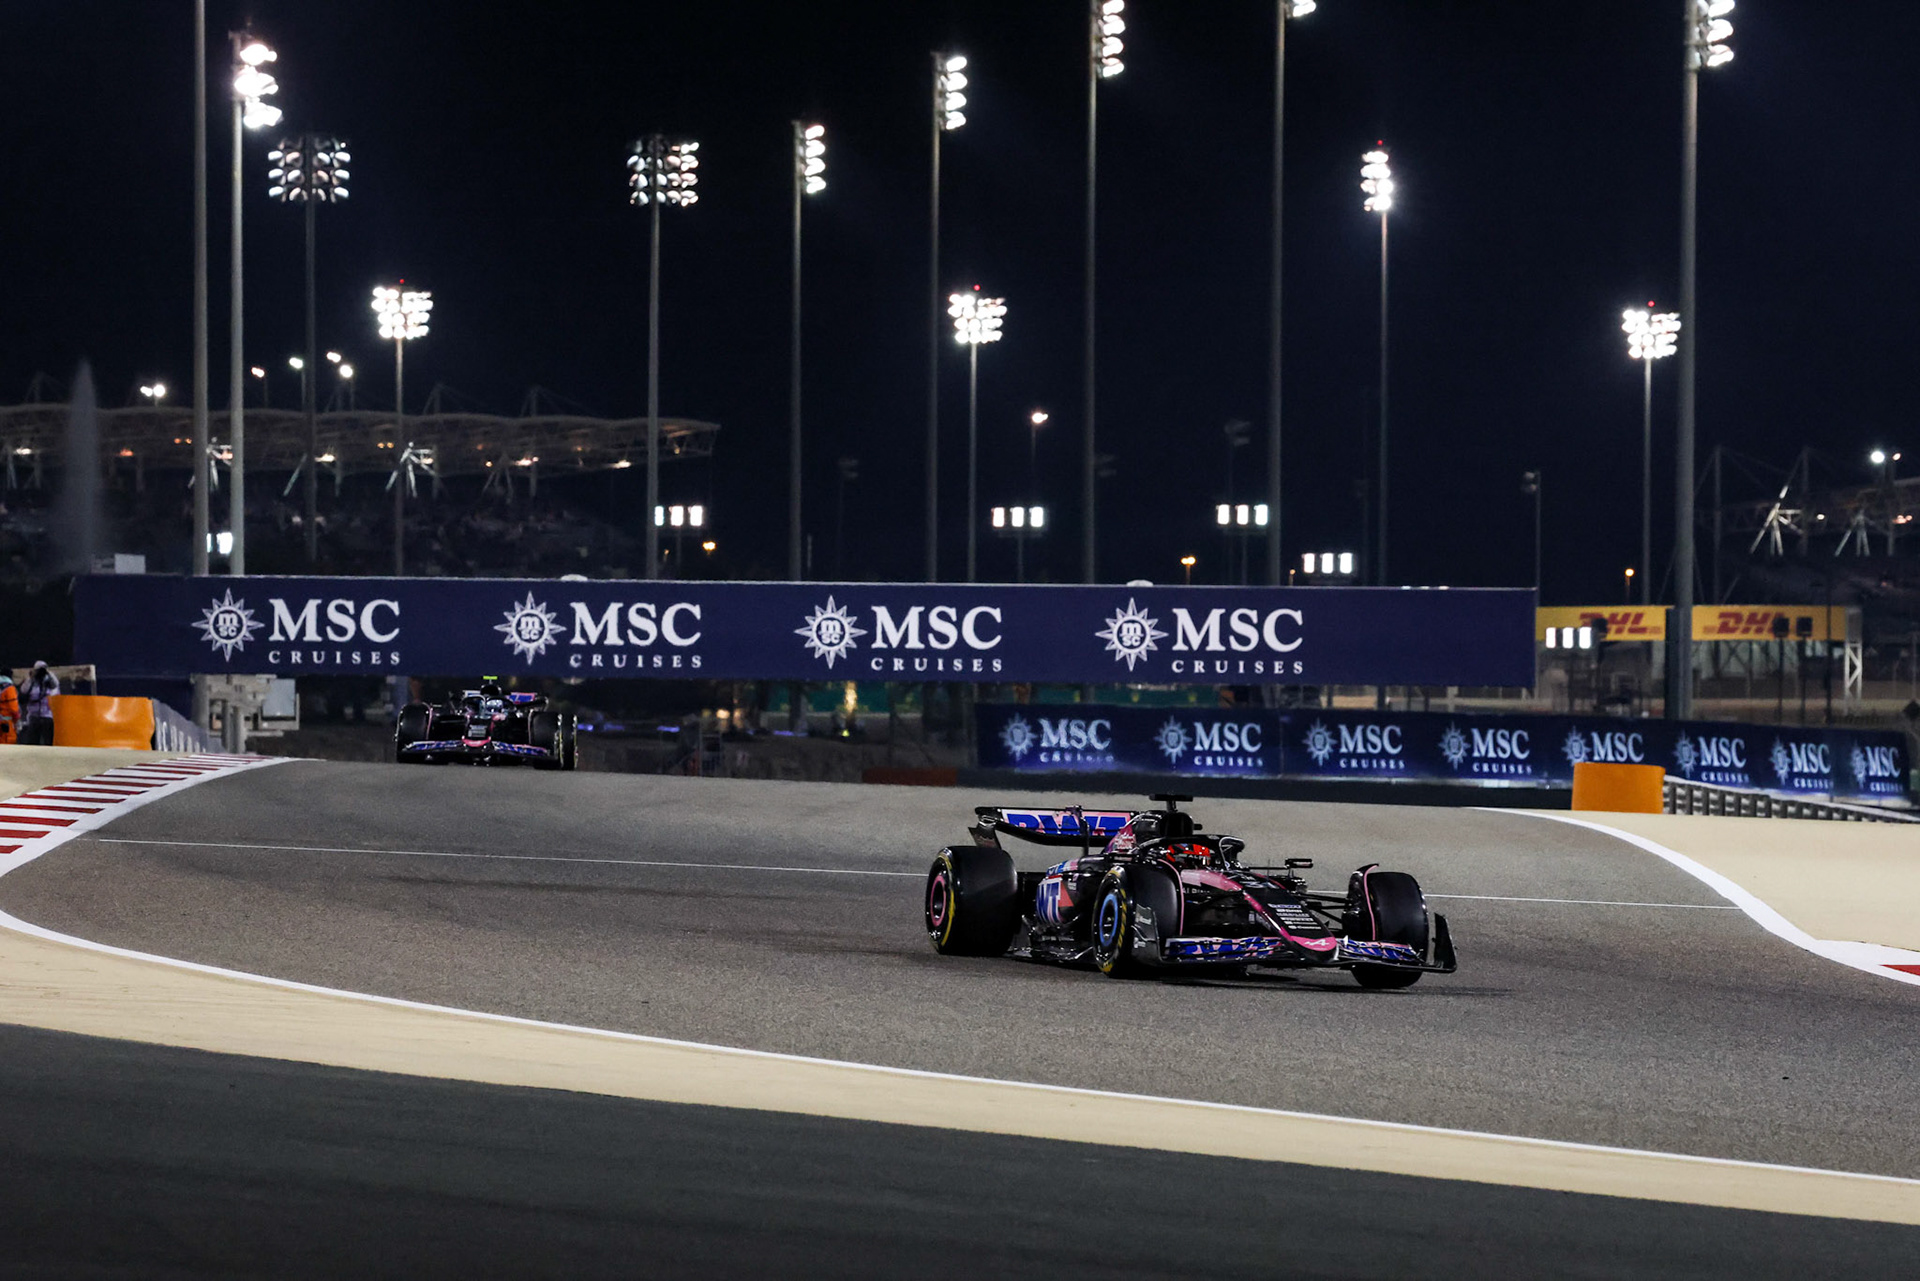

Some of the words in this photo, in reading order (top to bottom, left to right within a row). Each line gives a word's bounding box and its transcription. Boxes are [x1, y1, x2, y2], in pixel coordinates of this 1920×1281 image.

[269, 599, 401, 642] MSC
[570, 602, 702, 646] MSC
[871, 605, 1002, 650] MSC
[1172, 608, 1304, 653] MSC
[1717, 611, 1785, 634] DH
[269, 650, 401, 665] CRUISES
[570, 653, 702, 668] CRUISES
[871, 657, 1002, 672] CRUISES
[1172, 660, 1303, 674] CRUISES
[1039, 719, 1111, 751] MSC
[1194, 722, 1262, 753] MSC
[1339, 724, 1403, 754] MSC
[1471, 728, 1530, 759] MSC
[1591, 733, 1645, 762] MSC
[1698, 737, 1746, 768] MSC
[1790, 742, 1831, 774] MSC
[1864, 746, 1901, 778] MSC
